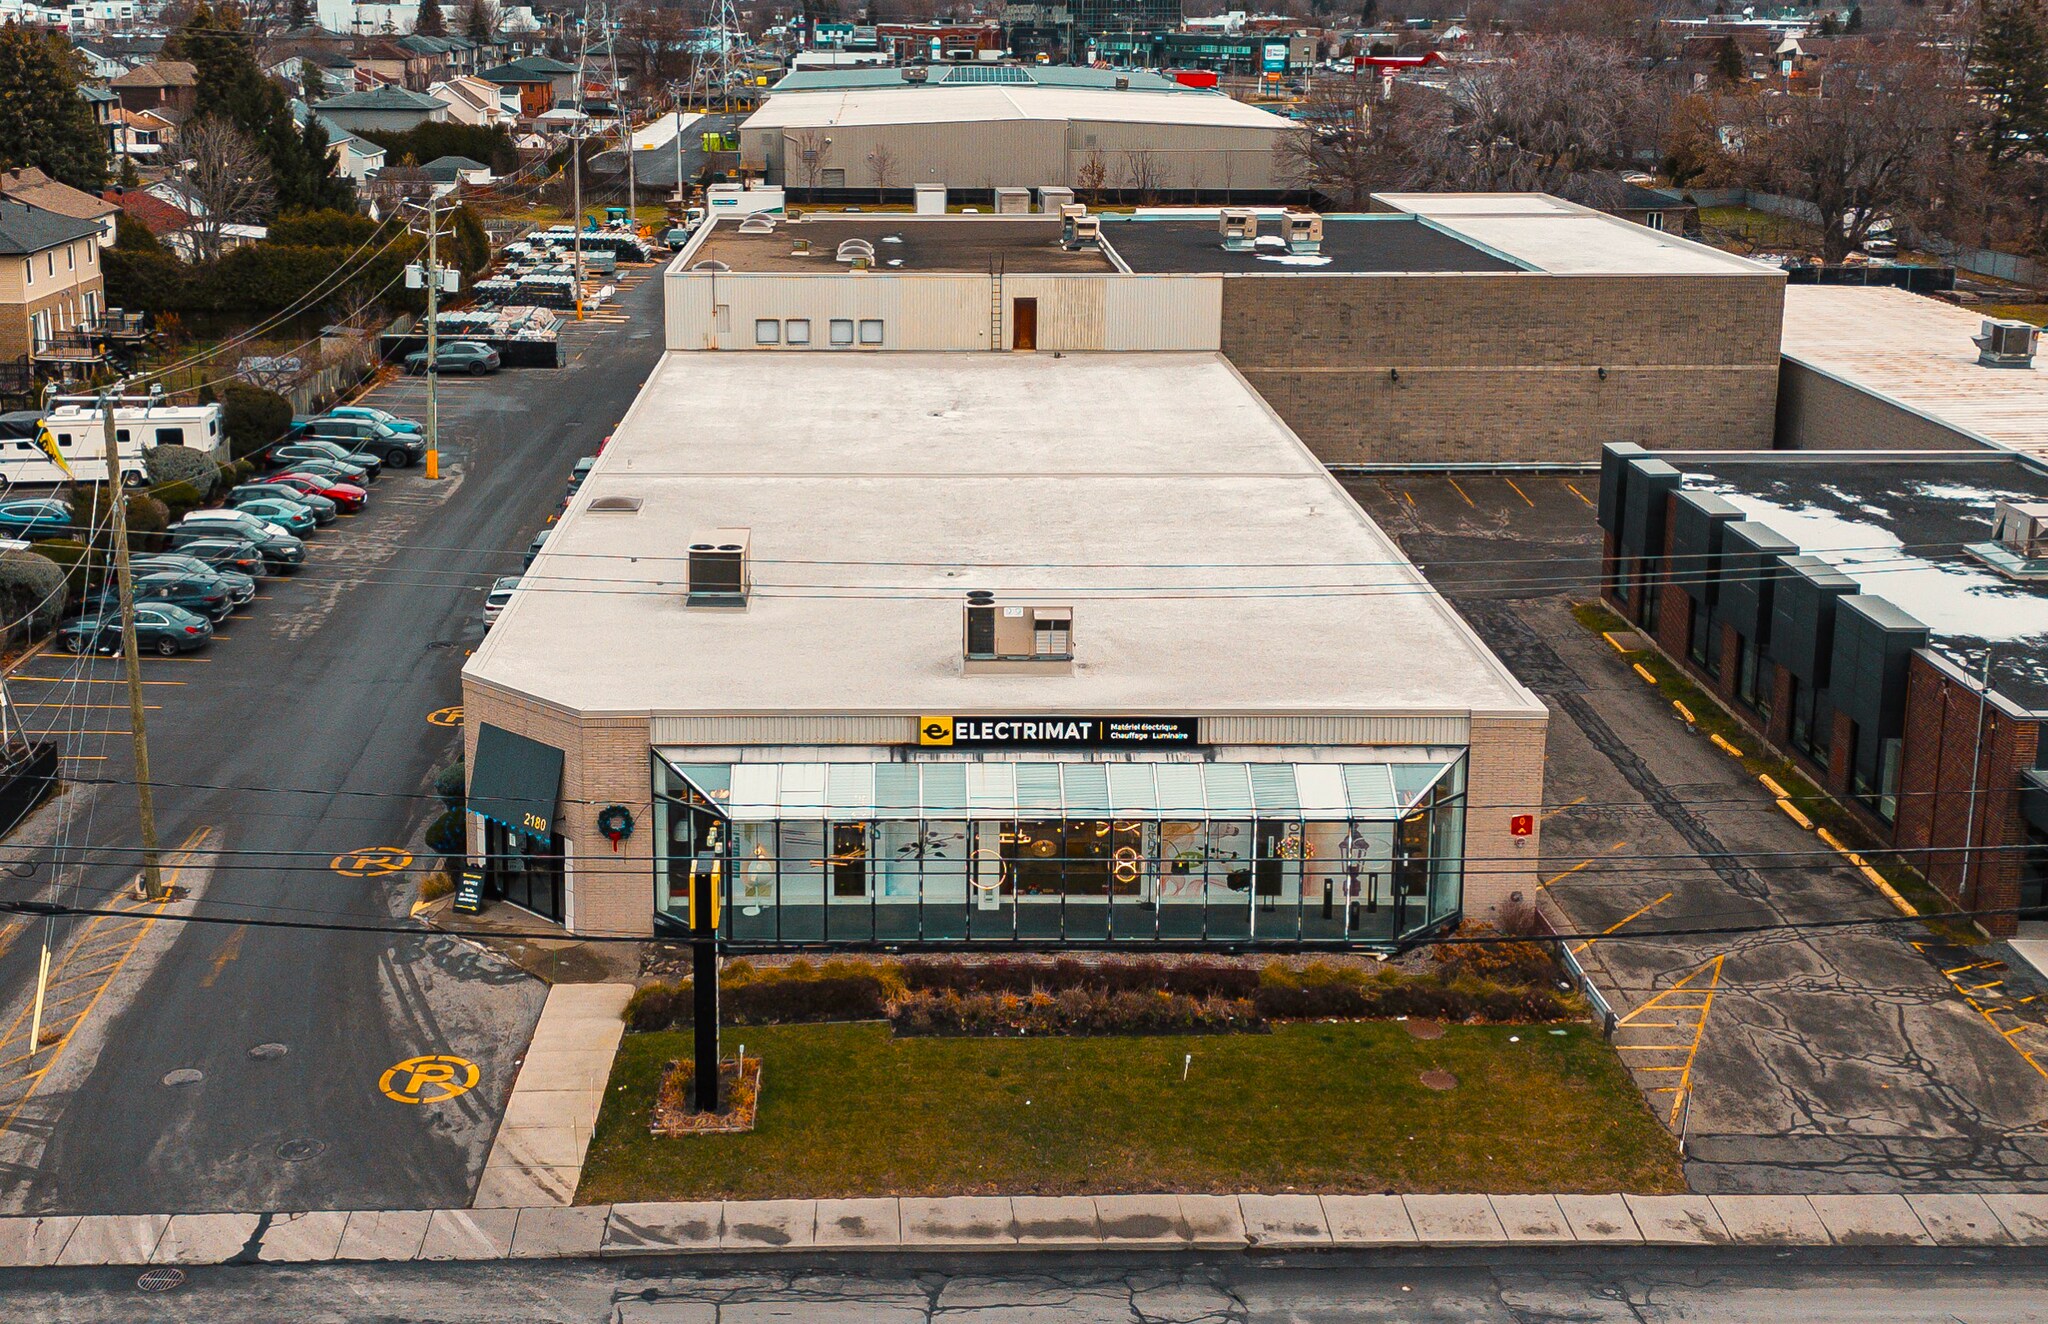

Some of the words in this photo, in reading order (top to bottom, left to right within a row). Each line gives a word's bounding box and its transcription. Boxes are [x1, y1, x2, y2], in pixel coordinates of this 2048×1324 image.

[955, 722, 1092, 740] ELECTRIMAT
[1110, 723, 1140, 731] Matériel
[1141, 723, 1178, 732] électrique
[1110, 732, 1148, 741] Chauffage
[1152, 732, 1189, 740] Luminaire
[523, 812, 547, 832] 2180
